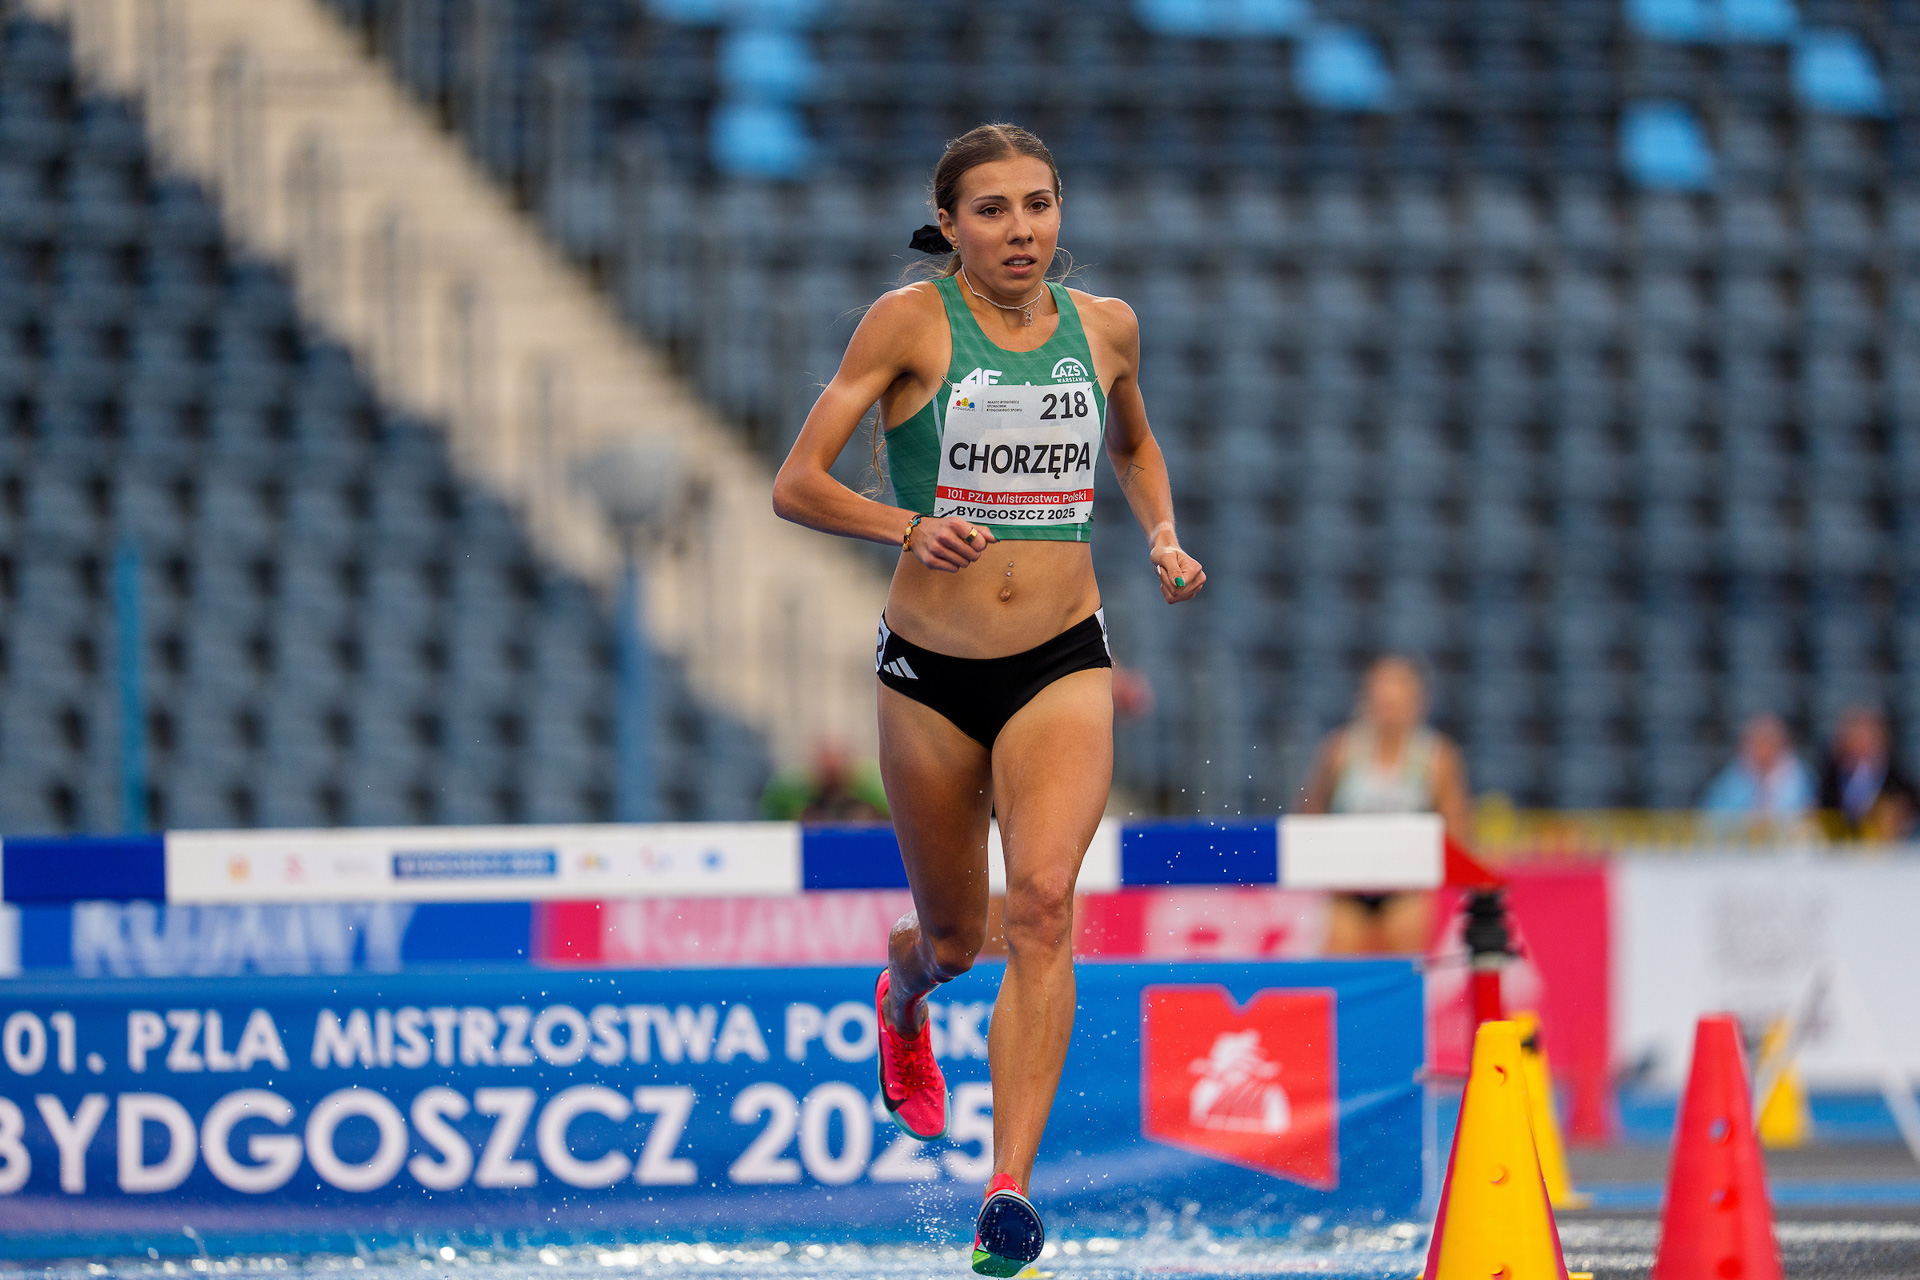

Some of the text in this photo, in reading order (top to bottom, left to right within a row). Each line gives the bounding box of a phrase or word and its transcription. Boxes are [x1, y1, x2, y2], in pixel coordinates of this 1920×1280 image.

[1059, 364, 1081, 378] AZS
[1040, 391, 1089, 420] 218
[949, 442, 1091, 480] CHORZĘPA
[947, 488, 1087, 504] 101. PZLA Mistrzostwa Polski
[956, 506, 1076, 520] BYDGOSZCZ 2025
[127, 1008, 290, 1073] PZLA
[311, 1002, 770, 1069] MISTRZOSTWA
[784, 1000, 990, 1062] POSK
[728, 1080, 995, 1186] 2025
